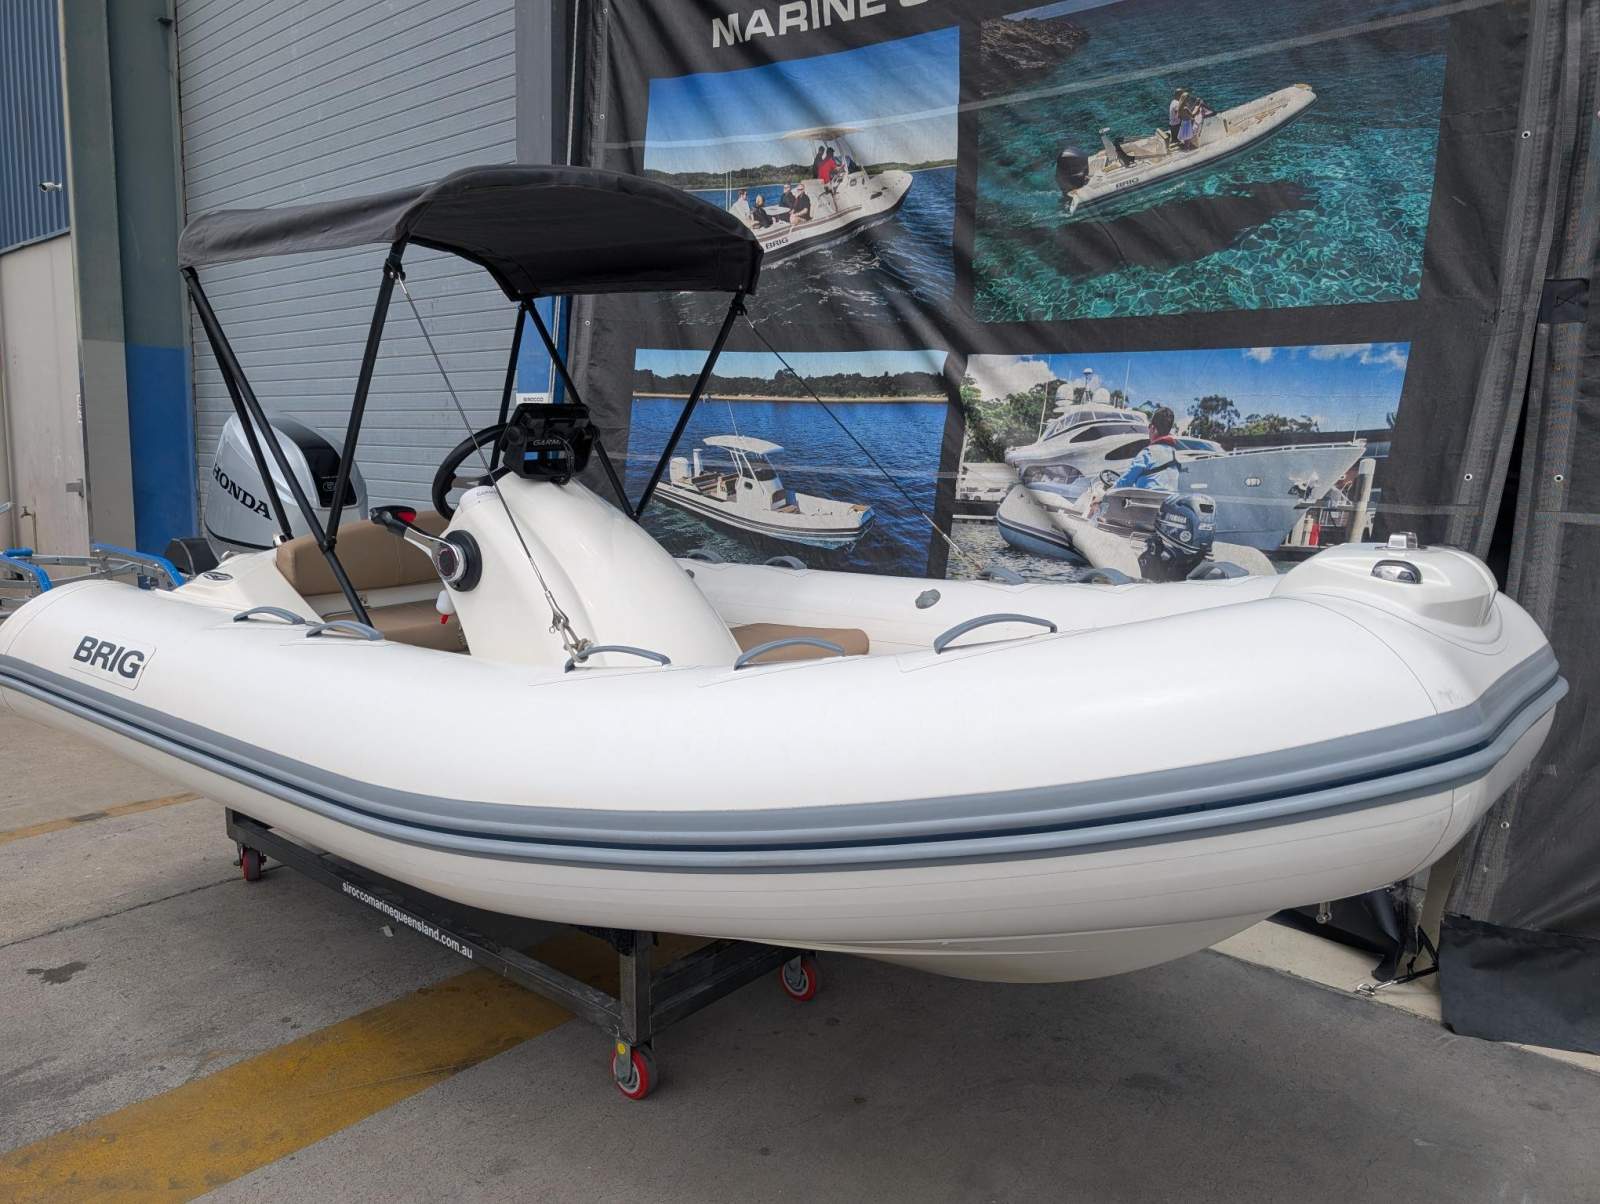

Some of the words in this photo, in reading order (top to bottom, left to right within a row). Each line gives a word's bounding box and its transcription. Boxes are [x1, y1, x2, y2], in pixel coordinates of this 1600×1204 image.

[712, 0, 886, 48] MARINE
[213, 463, 272, 521] HONDA
[73, 635, 145, 679] BRIG
[342, 881, 473, 959] siroccomarinequeensland.com.au
